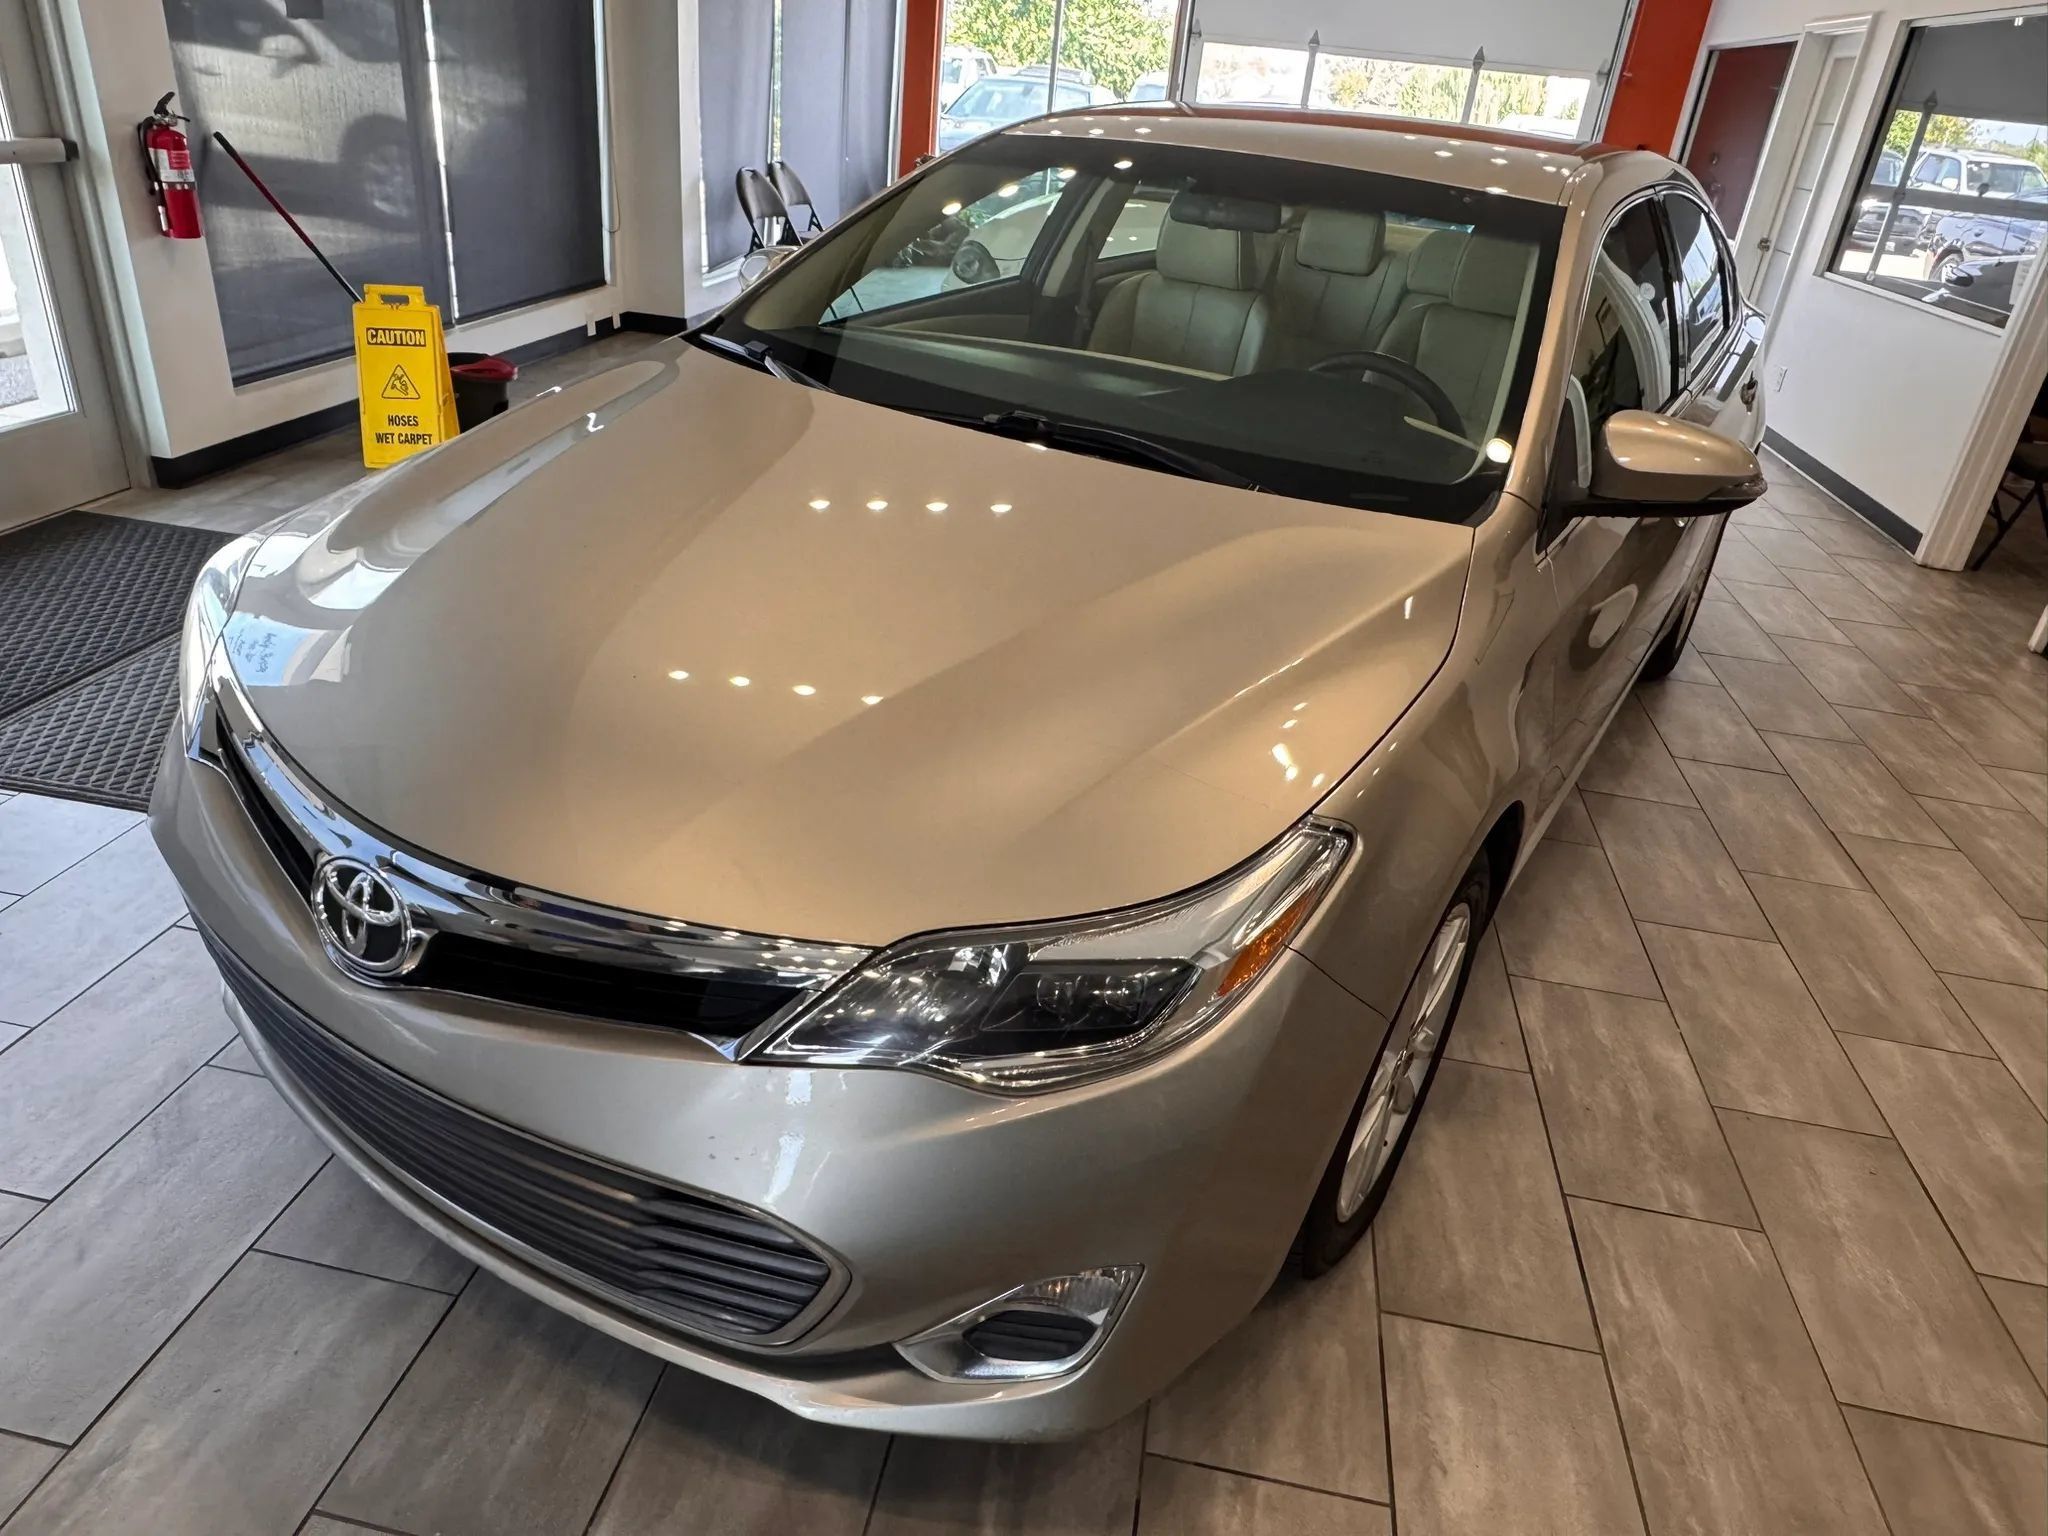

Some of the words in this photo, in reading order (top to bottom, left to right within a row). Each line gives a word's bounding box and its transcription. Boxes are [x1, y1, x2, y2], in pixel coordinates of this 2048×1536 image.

[367, 328, 425, 345] CAUTION
[387, 415, 419, 427] HOSES
[375, 432, 395, 445] WET
[397, 432, 433, 446] CARPET
